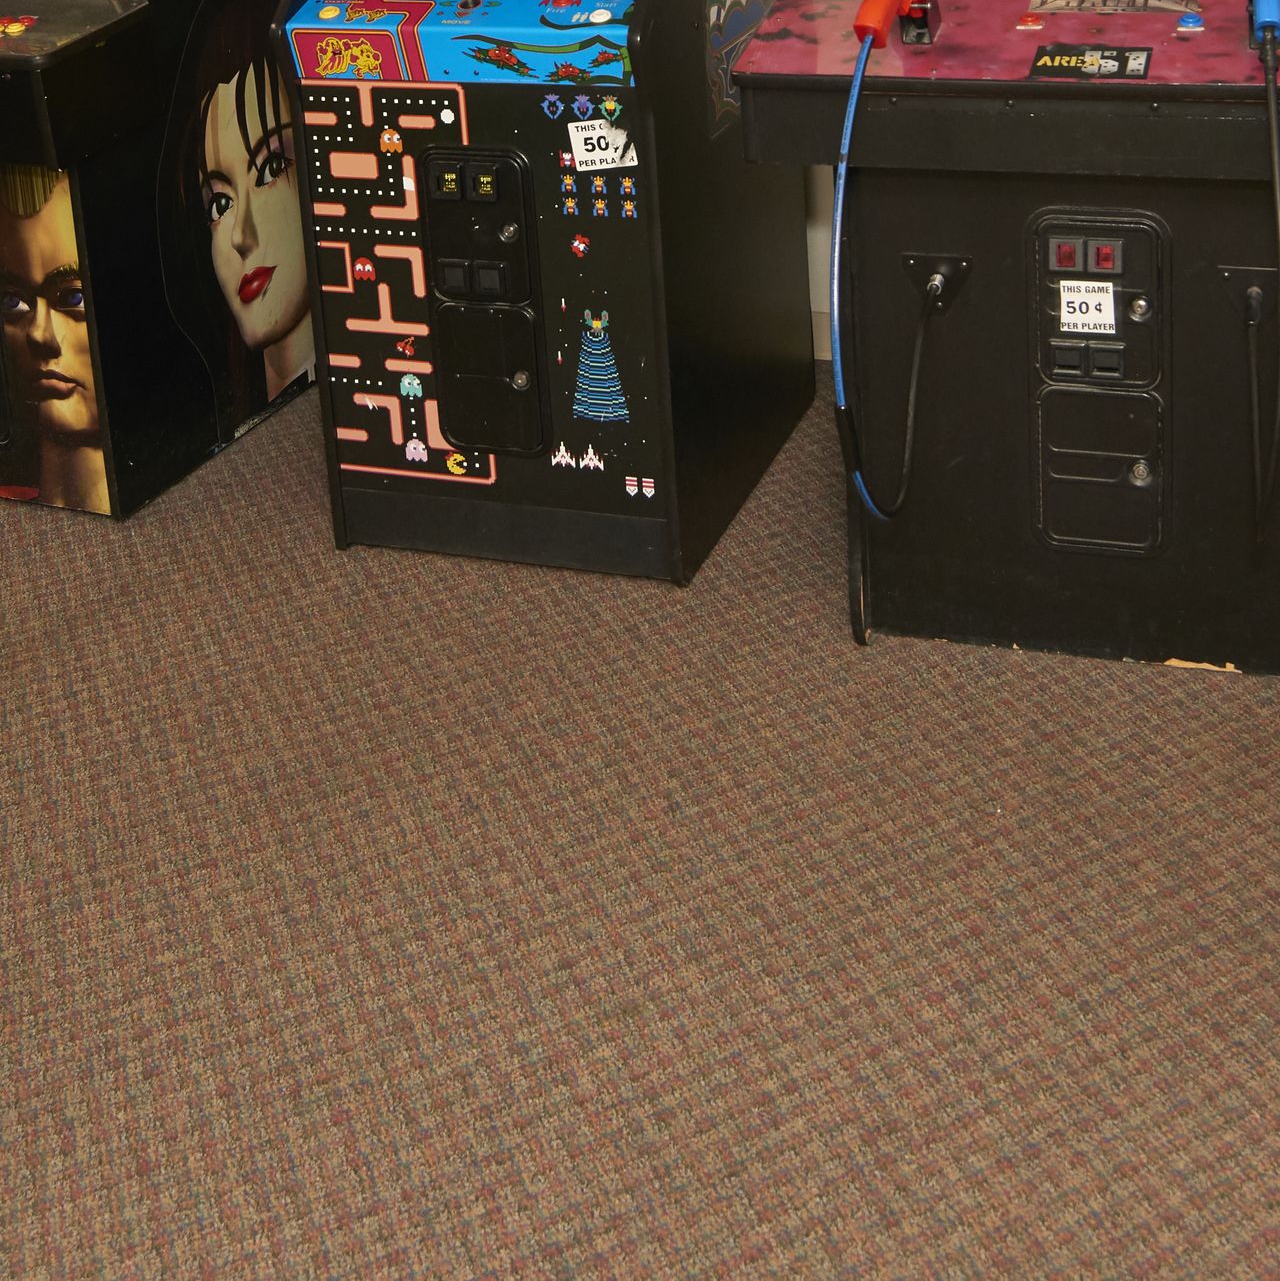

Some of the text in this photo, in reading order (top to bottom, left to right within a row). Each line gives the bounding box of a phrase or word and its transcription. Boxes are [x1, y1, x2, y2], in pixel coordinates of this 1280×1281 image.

[1036, 50, 1148, 75] AREA 51
[574, 123, 596, 133] THIS
[578, 159, 597, 167] PER
[1062, 284, 1111, 295] THIS GAME
[1066, 300, 1090, 315] 50
[1060, 321, 1116, 332] PER PLAYER
